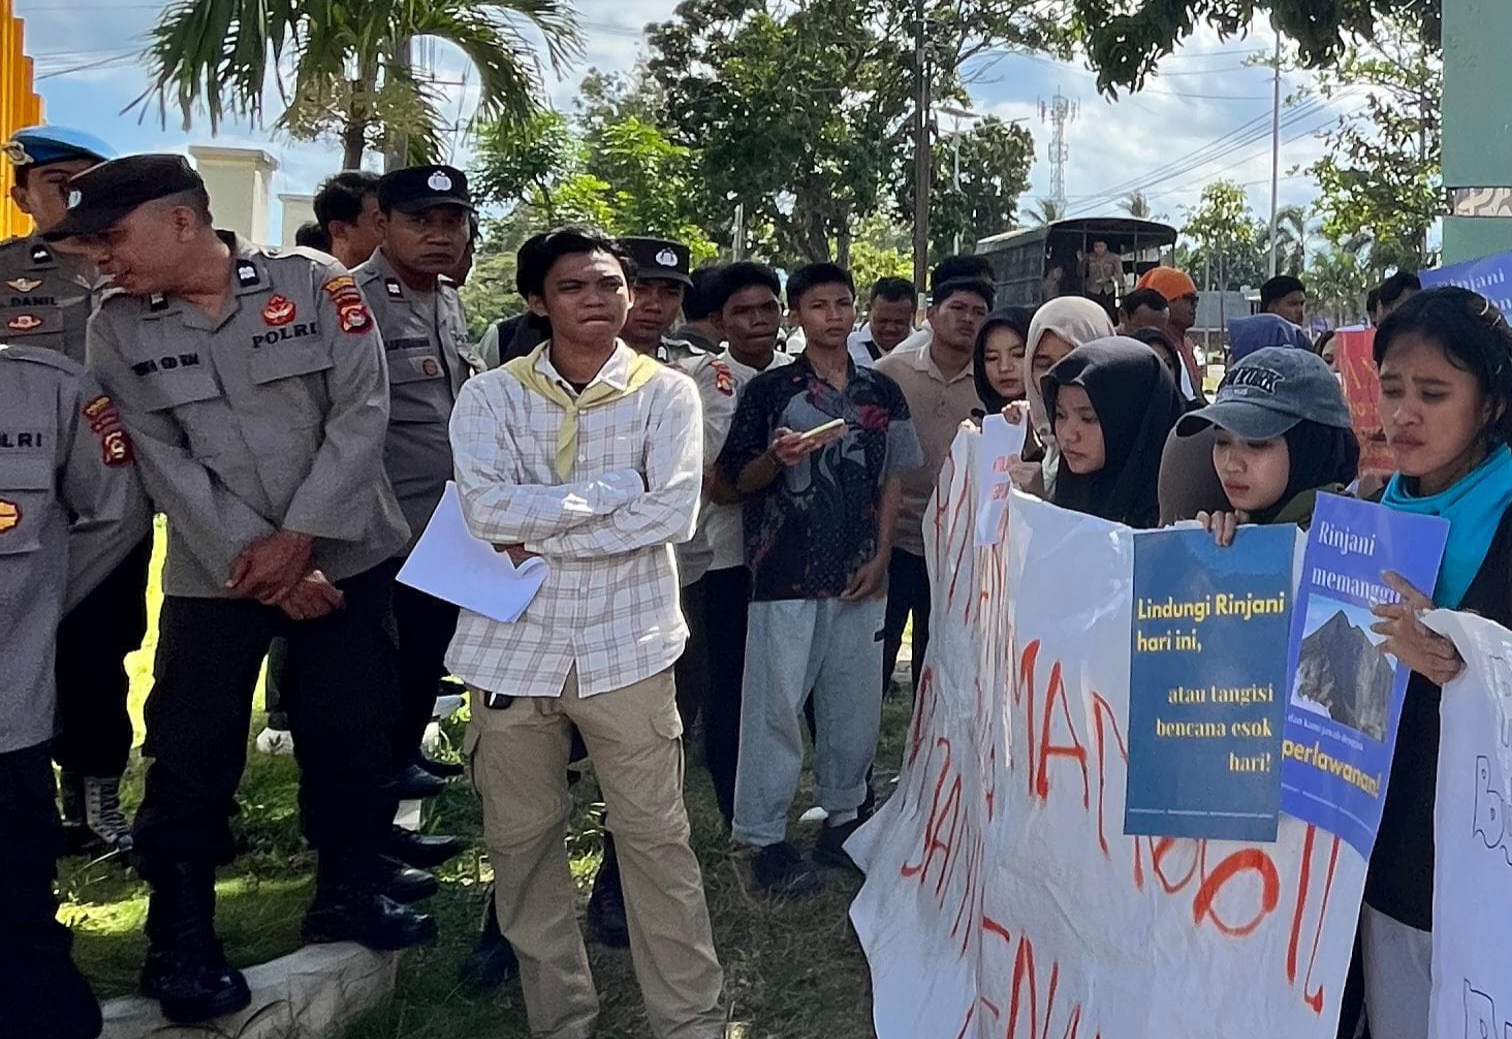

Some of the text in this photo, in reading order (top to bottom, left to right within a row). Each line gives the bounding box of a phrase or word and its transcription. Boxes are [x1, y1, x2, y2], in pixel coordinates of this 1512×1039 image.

[252, 321, 318, 349] POLRI
[1318, 520, 1376, 556] Rinjani
[1137, 591, 1285, 623] Lindungi Rinjani
[1136, 628, 1203, 653] hari ini,
[1167, 682, 1275, 706] atau tangisi
[1155, 717, 1273, 738] bencana esok
[1228, 751, 1272, 773] hari!
[1281, 739, 1383, 800] perlawanan!
